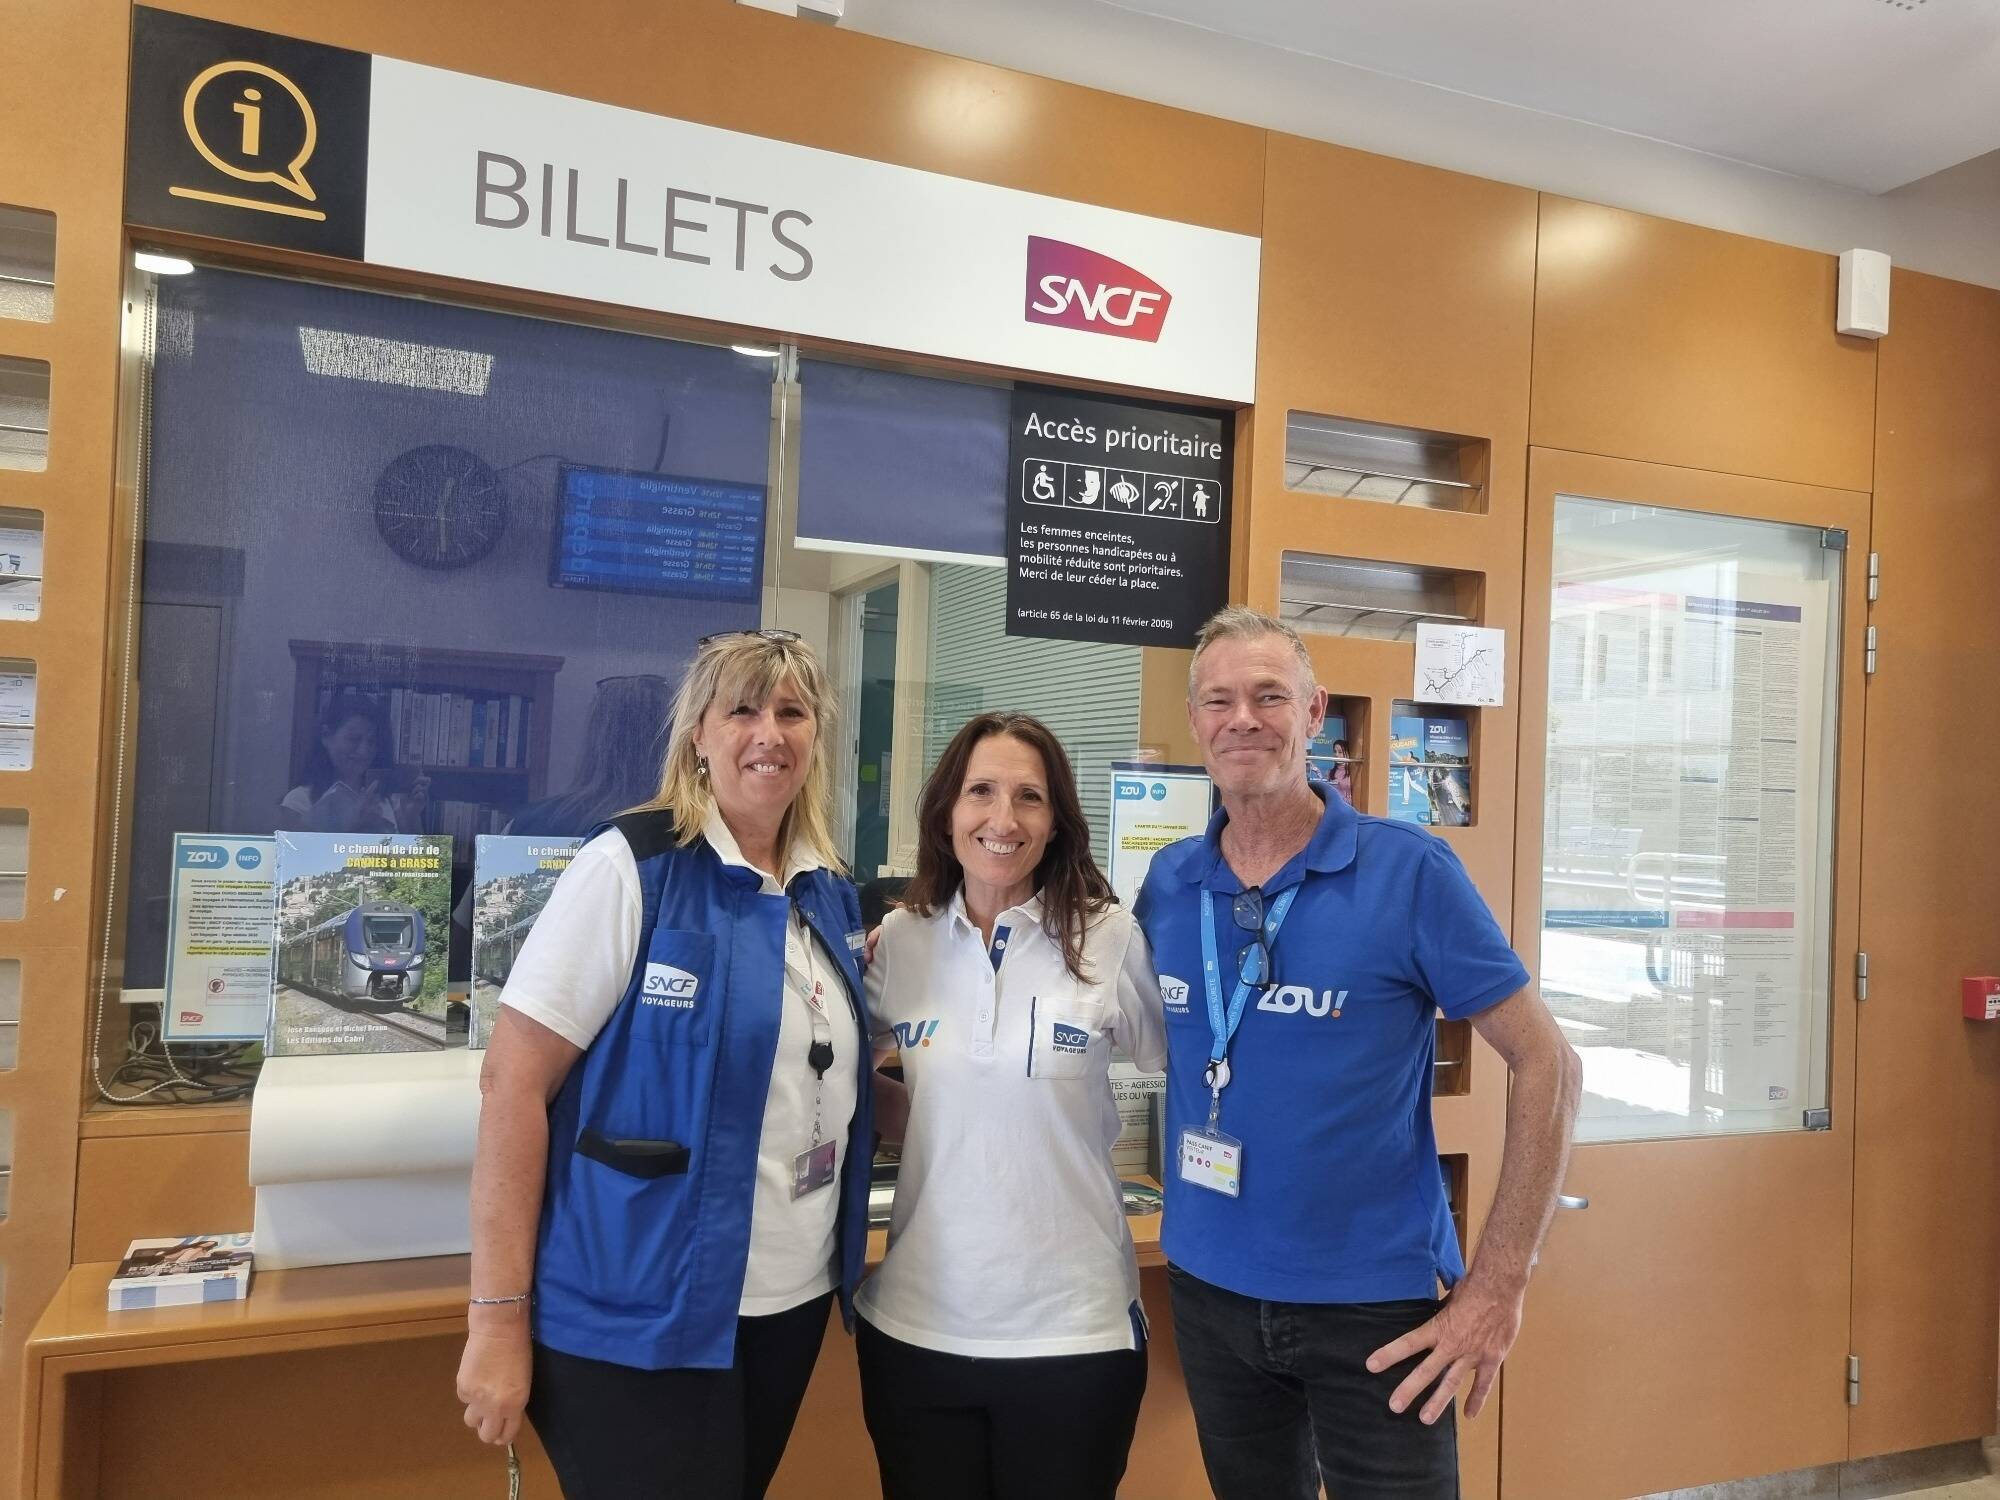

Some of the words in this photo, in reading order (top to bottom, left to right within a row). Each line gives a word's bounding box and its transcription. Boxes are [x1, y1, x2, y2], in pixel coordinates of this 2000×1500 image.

[475, 150, 814, 281] BILLETS
[1032, 274, 1162, 327] SNCF
[1024, 412, 1097, 444] Accès
[1105, 426, 1222, 460] prioritaire
[1020, 522, 1038, 534] Les
[1041, 525, 1082, 538] femmes
[1084, 529, 1135, 545] enceintes,
[1020, 538, 1035, 549] les
[1037, 542, 1089, 555] personnes
[1092, 545, 1153, 562] handicapées
[1156, 552, 1168, 562] ou
[1170, 552, 1176, 563] à
[1020, 553, 1062, 567] mobilité
[1065, 557, 1101, 570] réduite
[1103, 561, 1126, 572] sont
[1128, 564, 1184, 578] prioritaires.
[1019, 568, 1048, 580] Merci
[1050, 570, 1064, 581] de
[1066, 571, 1086, 583] leur
[1088, 574, 1117, 587] céder
[1118, 576, 1128, 587] la
[1130, 578, 1160, 591] place.
[1017, 608, 1048, 619] (article
[1050, 611, 1061, 620] 65
[1062, 612, 1073, 621] de
[1075, 613, 1083, 622] la
[1086, 613, 1096, 623] loi
[1098, 615, 1109, 624] du
[1111, 615, 1120, 624] 11
[1122, 616, 1149, 627] février
[1150, 619, 1173, 629] 2005)
[333, 844, 346, 854] Le
[348, 844, 390, 855] chemin
[392, 844, 406, 855] de
[408, 844, 424, 855] fer
[426, 844, 440, 855] de
[527, 846, 539, 856] Le
[238, 854, 259, 862] INFO
[346, 857, 388, 868] CANNES
[390, 858, 397, 868] à
[400, 858, 440, 869] GRASSE
[646, 976, 696, 993] SNCF
[641, 996, 695, 1009] VOYAGEURS
[1256, 983, 1348, 1018] ZOU!
[344, 1025, 366, 1033] Michel
[368, 1024, 388, 1032] Braun
[333, 1036, 343, 1044] du
[344, 1035, 365, 1043] Cabri
[1055, 1032, 1088, 1044] SNCF
[1052, 1045, 1087, 1054] VOYAGEURS
[1129, 1092, 1141, 1100] OU
